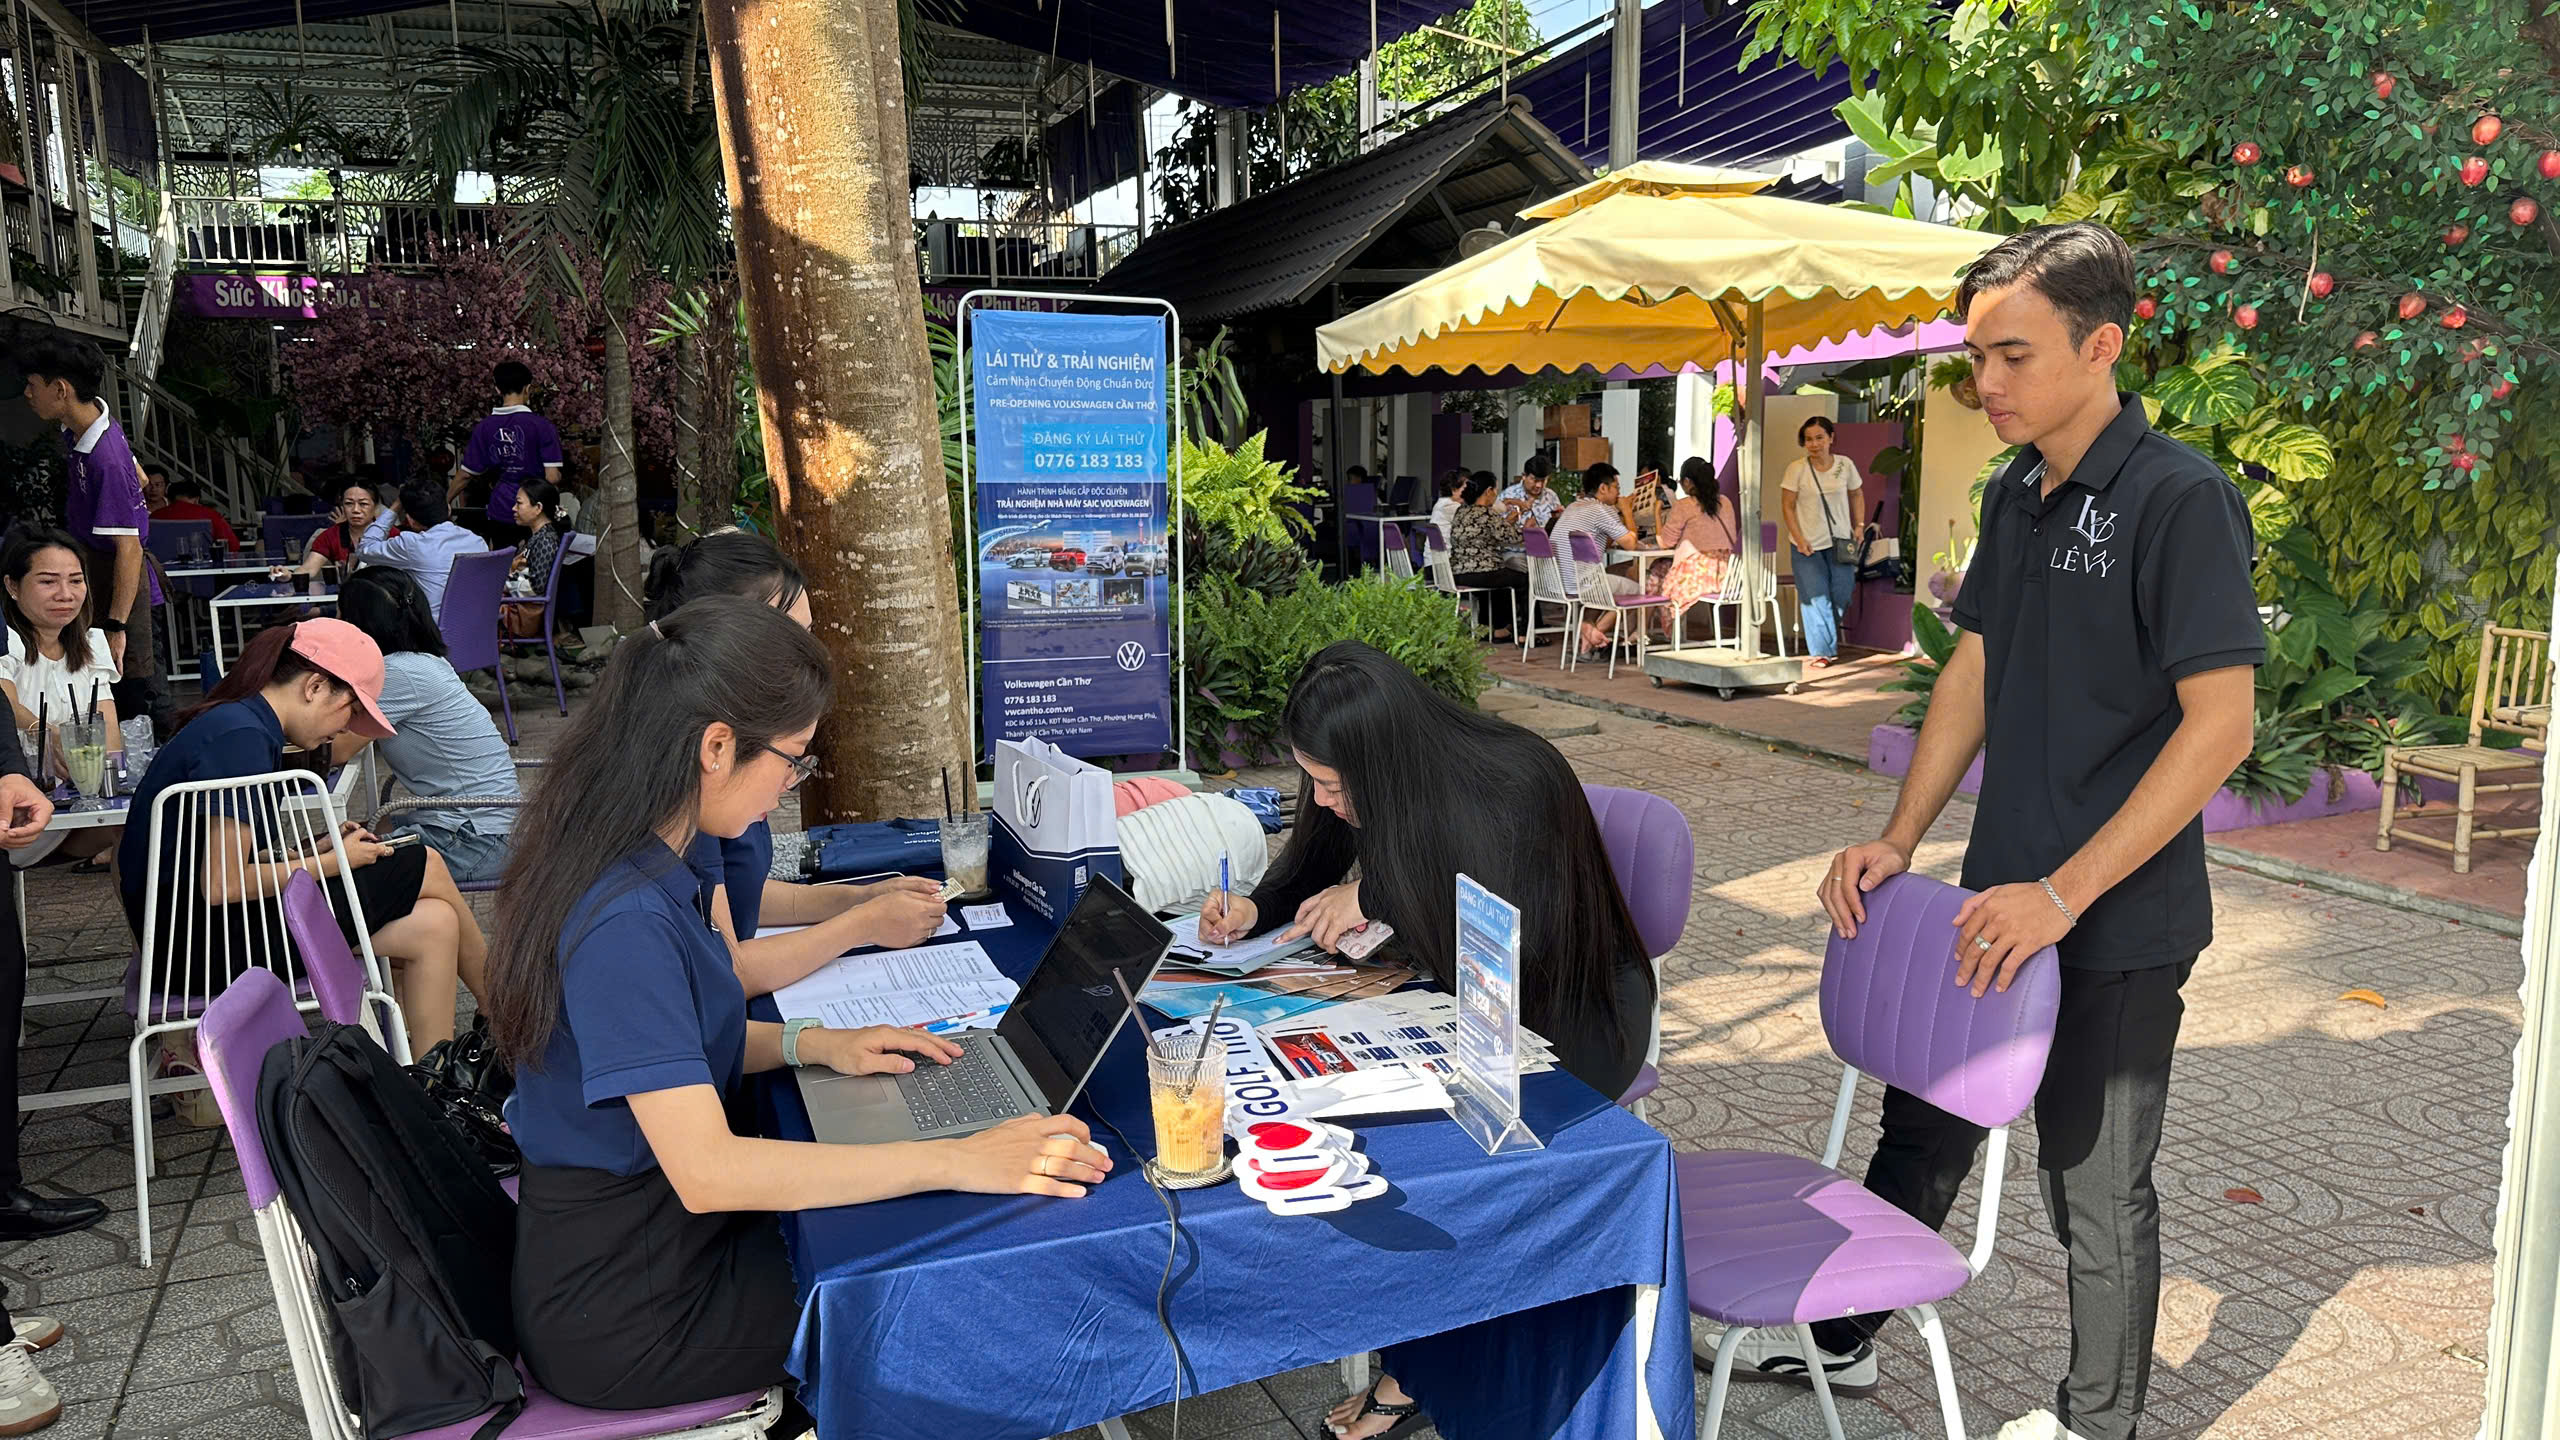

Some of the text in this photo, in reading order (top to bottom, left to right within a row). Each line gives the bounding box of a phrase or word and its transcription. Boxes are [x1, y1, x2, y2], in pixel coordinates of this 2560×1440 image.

[215, 279, 255, 307] Sức
[986, 348, 1154, 374] LÁI THỬ & TRẢI NGHIỆM
[1010, 375, 1036, 388] Nhận
[1076, 377, 1101, 390] Động
[1134, 378, 1154, 390] Đức
[989, 399, 1051, 409] PRE-OPENING
[1053, 400, 1114, 409] VOLKSWAGEN
[1115, 398, 1135, 410] CẦN
[1076, 431, 1092, 445] KÝ
[1095, 431, 1113, 445] LÁI
[1118, 431, 1145, 446] THỬ
[1035, 453, 1143, 468] 0776 183 183
[1017, 486, 1037, 496] HÀNH
[996, 498, 1150, 510] TRẢI NGHIỆM NHÀ MÁY SAIC VOLKSWAGEN
[1004, 677, 1093, 690] Volkswagen Cần Thơ
[1004, 695, 1057, 705] 0776 183 183
[1004, 706, 1074, 716] vwcantho.com.vn
[1005, 719, 1018, 727] KDC
[1005, 729, 1025, 738] Thành
[1038, 726, 1051, 736] Cần
[1065, 726, 1078, 735] Việt
[1226, 1066, 1288, 1116] GOLF
